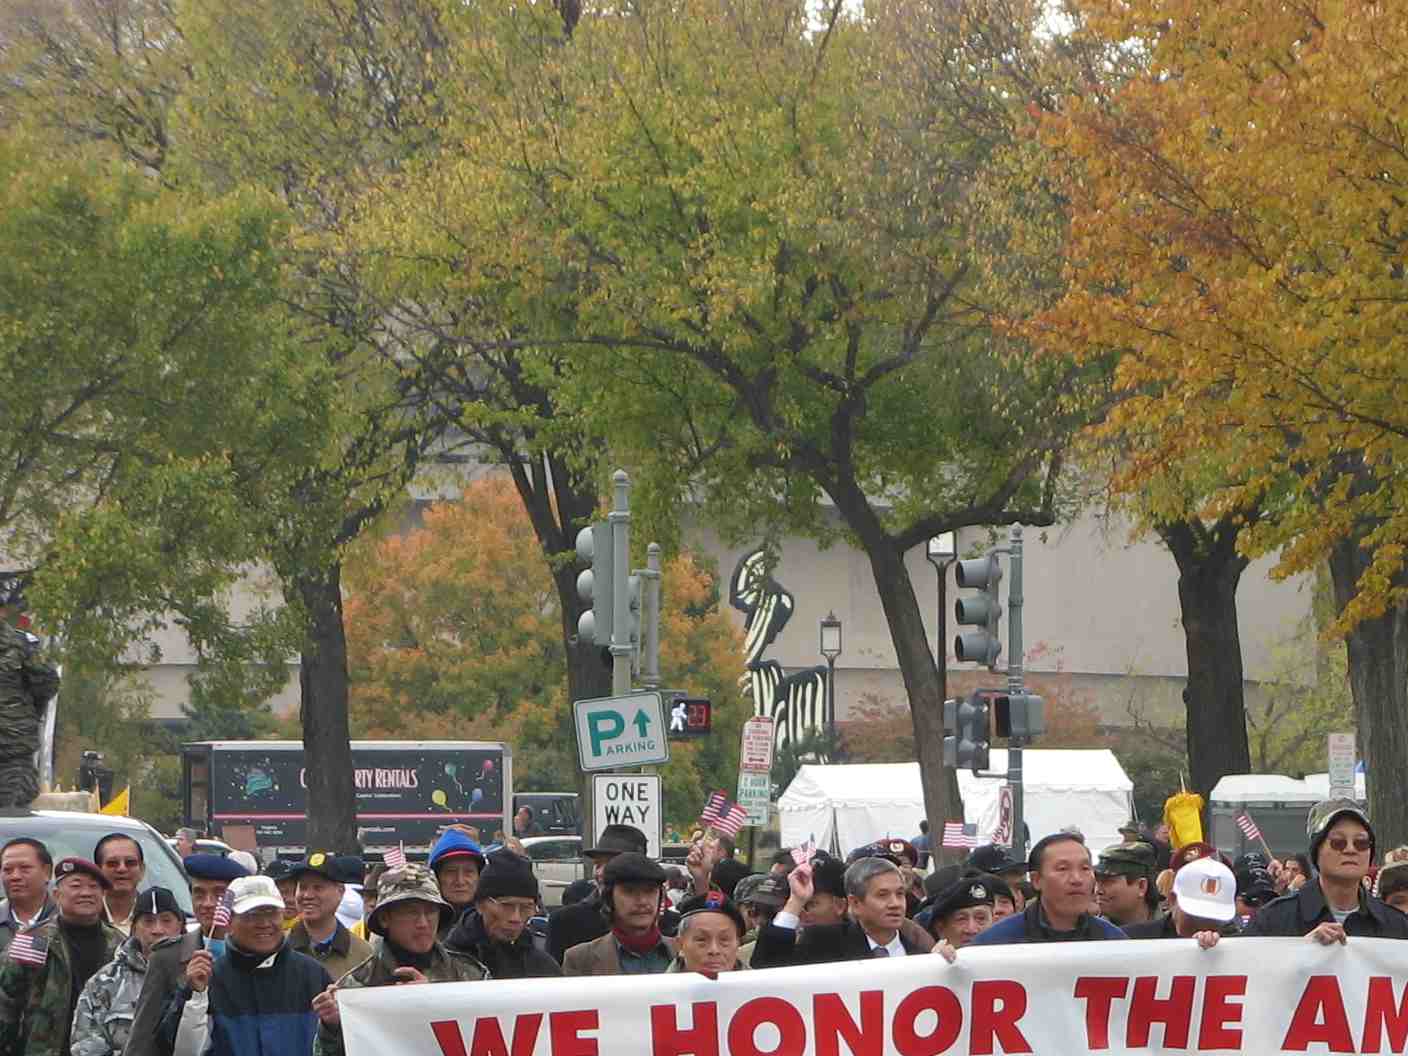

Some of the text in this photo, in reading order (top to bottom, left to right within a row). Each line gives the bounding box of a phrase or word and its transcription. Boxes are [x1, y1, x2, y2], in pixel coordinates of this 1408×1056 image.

[375, 768, 419, 789] RENTALS
[606, 782, 649, 802] ONE
[604, 806, 650, 825] WAY
[1073, 975, 1248, 1051] THE
